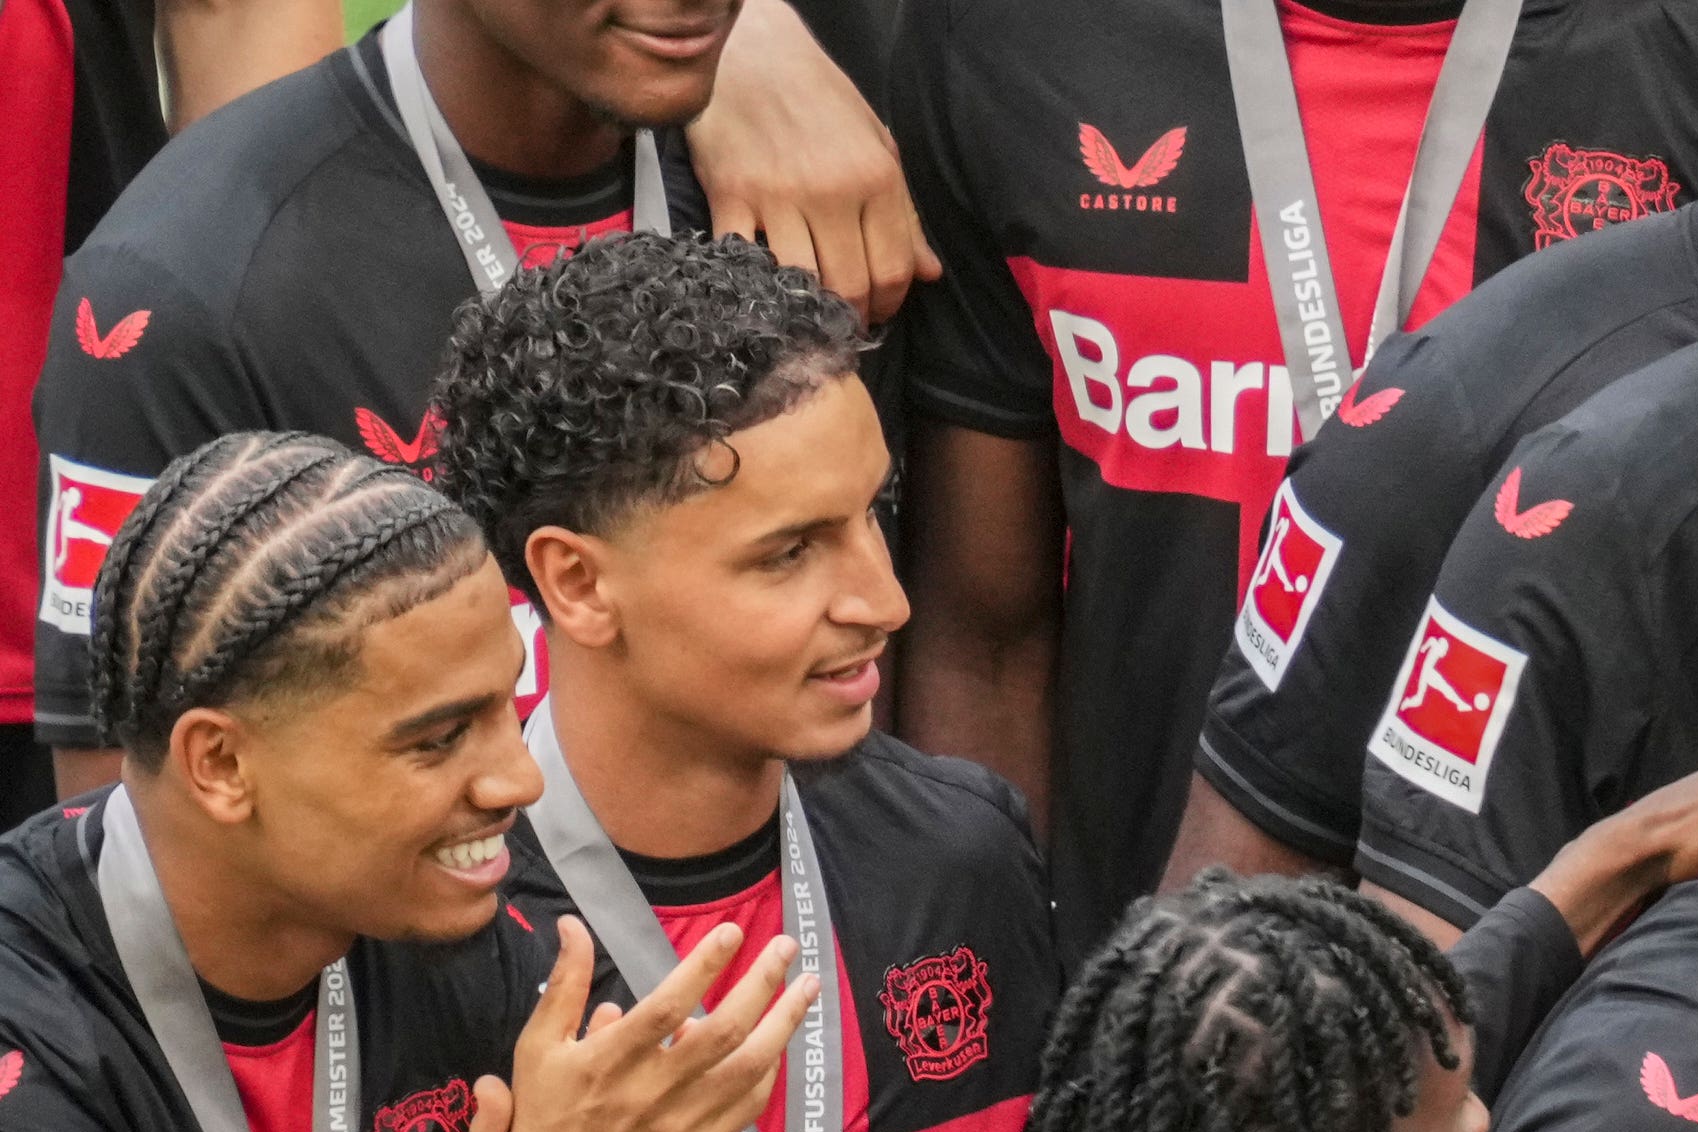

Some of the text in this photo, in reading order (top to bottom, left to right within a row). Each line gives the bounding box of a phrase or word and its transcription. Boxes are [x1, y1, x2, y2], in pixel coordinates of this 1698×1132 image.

[1589, 159, 1625, 176] 1904
[1079, 193, 1177, 213] CASTORE
[1570, 202, 1632, 221] BAYER
[475, 244, 505, 290] ER
[1279, 199, 1344, 421] BUNDESLIGA
[1383, 727, 1472, 792] BUNDESLIGA
[784, 811, 806, 875] 2024
[917, 1005, 961, 1030] BAYER
[914, 1042, 982, 1073] Leverkusen
